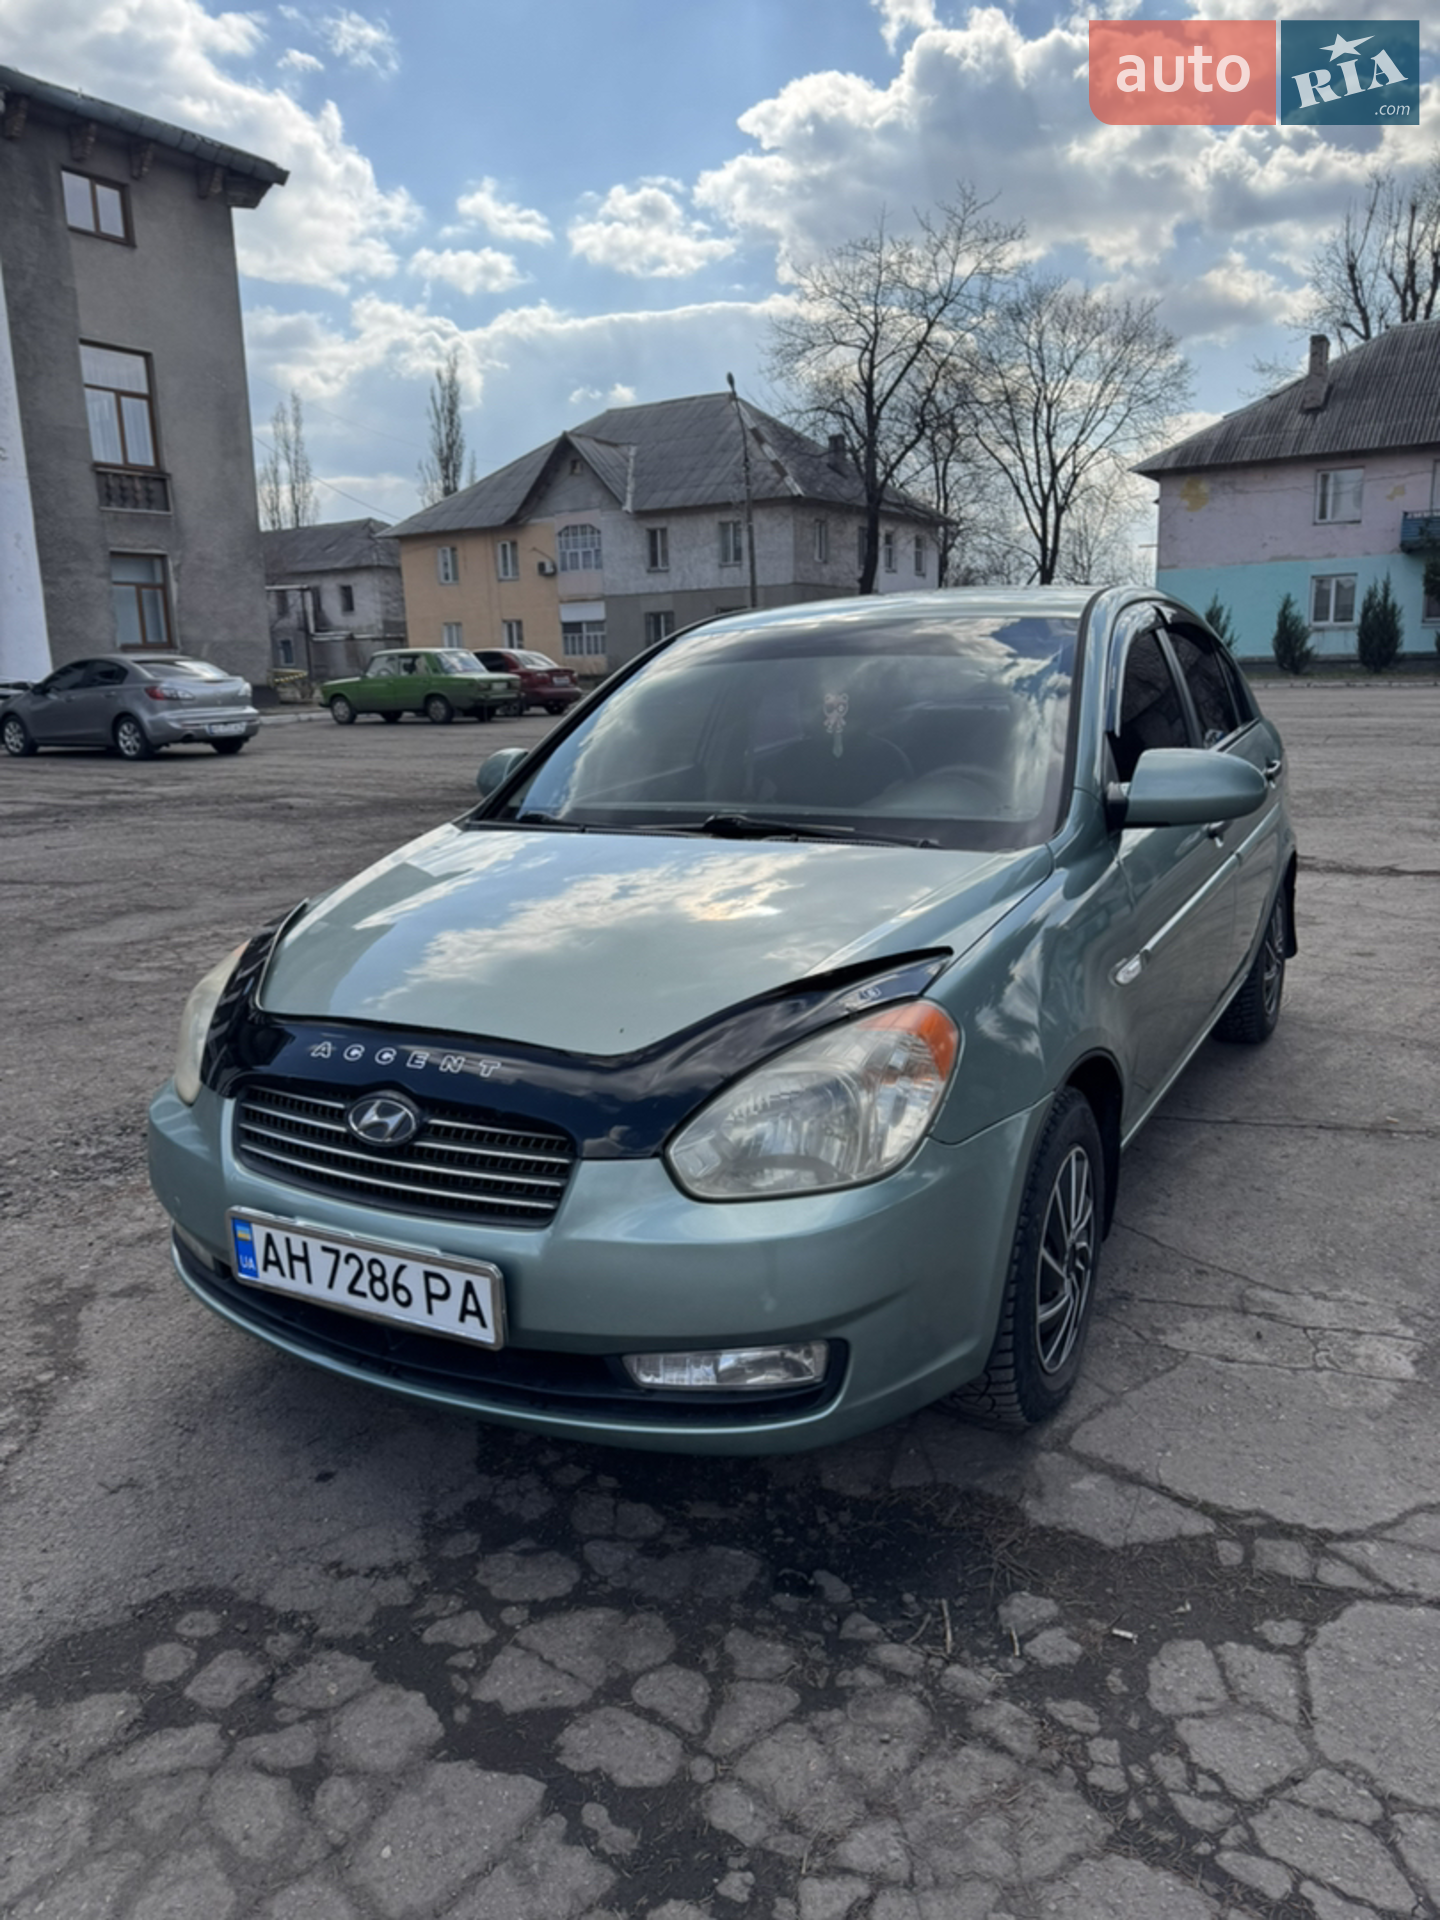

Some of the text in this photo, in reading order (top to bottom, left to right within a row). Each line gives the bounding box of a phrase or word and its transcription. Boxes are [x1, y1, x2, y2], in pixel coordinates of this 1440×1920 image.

[310, 1041, 500, 1077] ACCENT
[239, 1254, 257, 1271] UA
[320, 1245, 413, 1309] 7286
